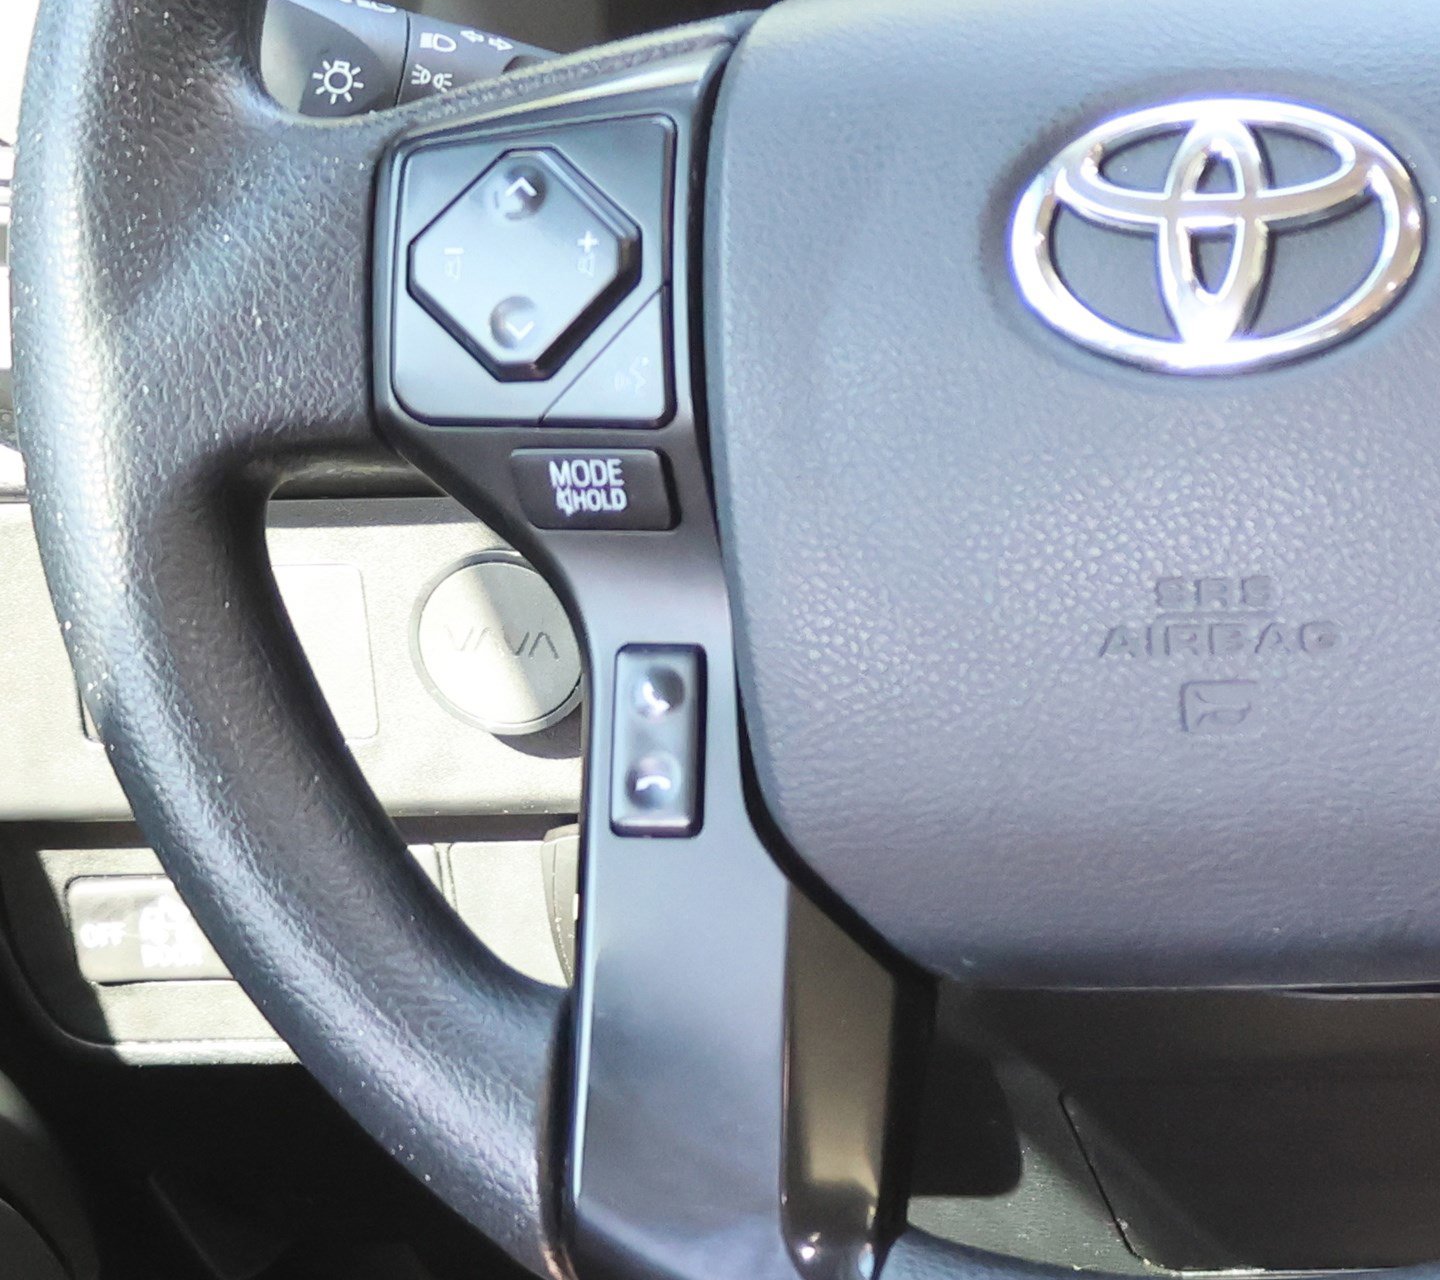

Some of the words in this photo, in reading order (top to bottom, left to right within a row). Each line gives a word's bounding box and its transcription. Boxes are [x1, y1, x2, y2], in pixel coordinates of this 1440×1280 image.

[549, 458, 625, 488] MODE
[573, 487, 627, 512] HOLD
[1099, 621, 1342, 658] AIRBAG
